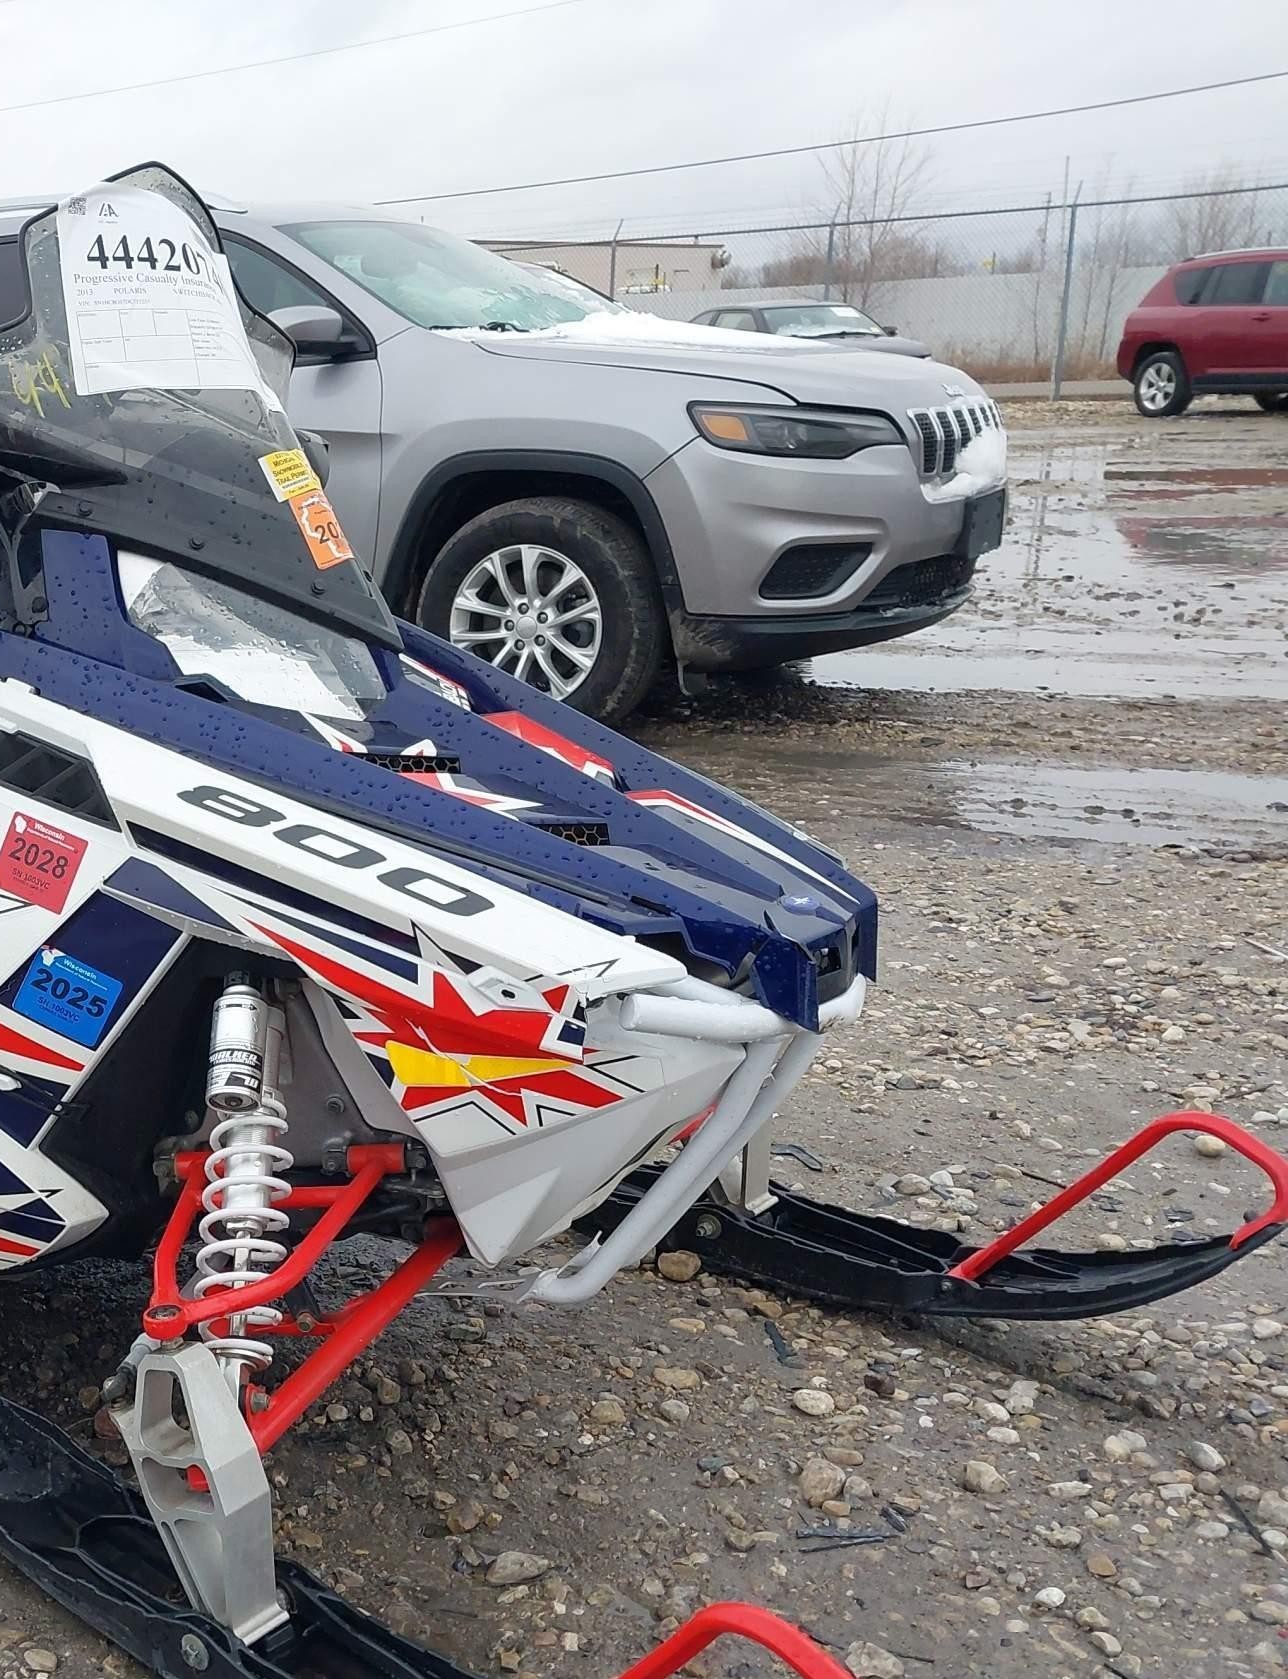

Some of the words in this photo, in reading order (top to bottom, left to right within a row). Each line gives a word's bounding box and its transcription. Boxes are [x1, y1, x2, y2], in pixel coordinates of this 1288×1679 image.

[73, 273, 134, 287] Progressive
[136, 273, 179, 287] Casualty
[113, 287, 147, 295] POLARIS
[315, 521, 340, 544] 20
[8, 837, 68, 879] 2028
[177, 785, 495, 917] 800
[63, 958, 97, 980] Wisconsin
[31, 967, 108, 1018] 2025
